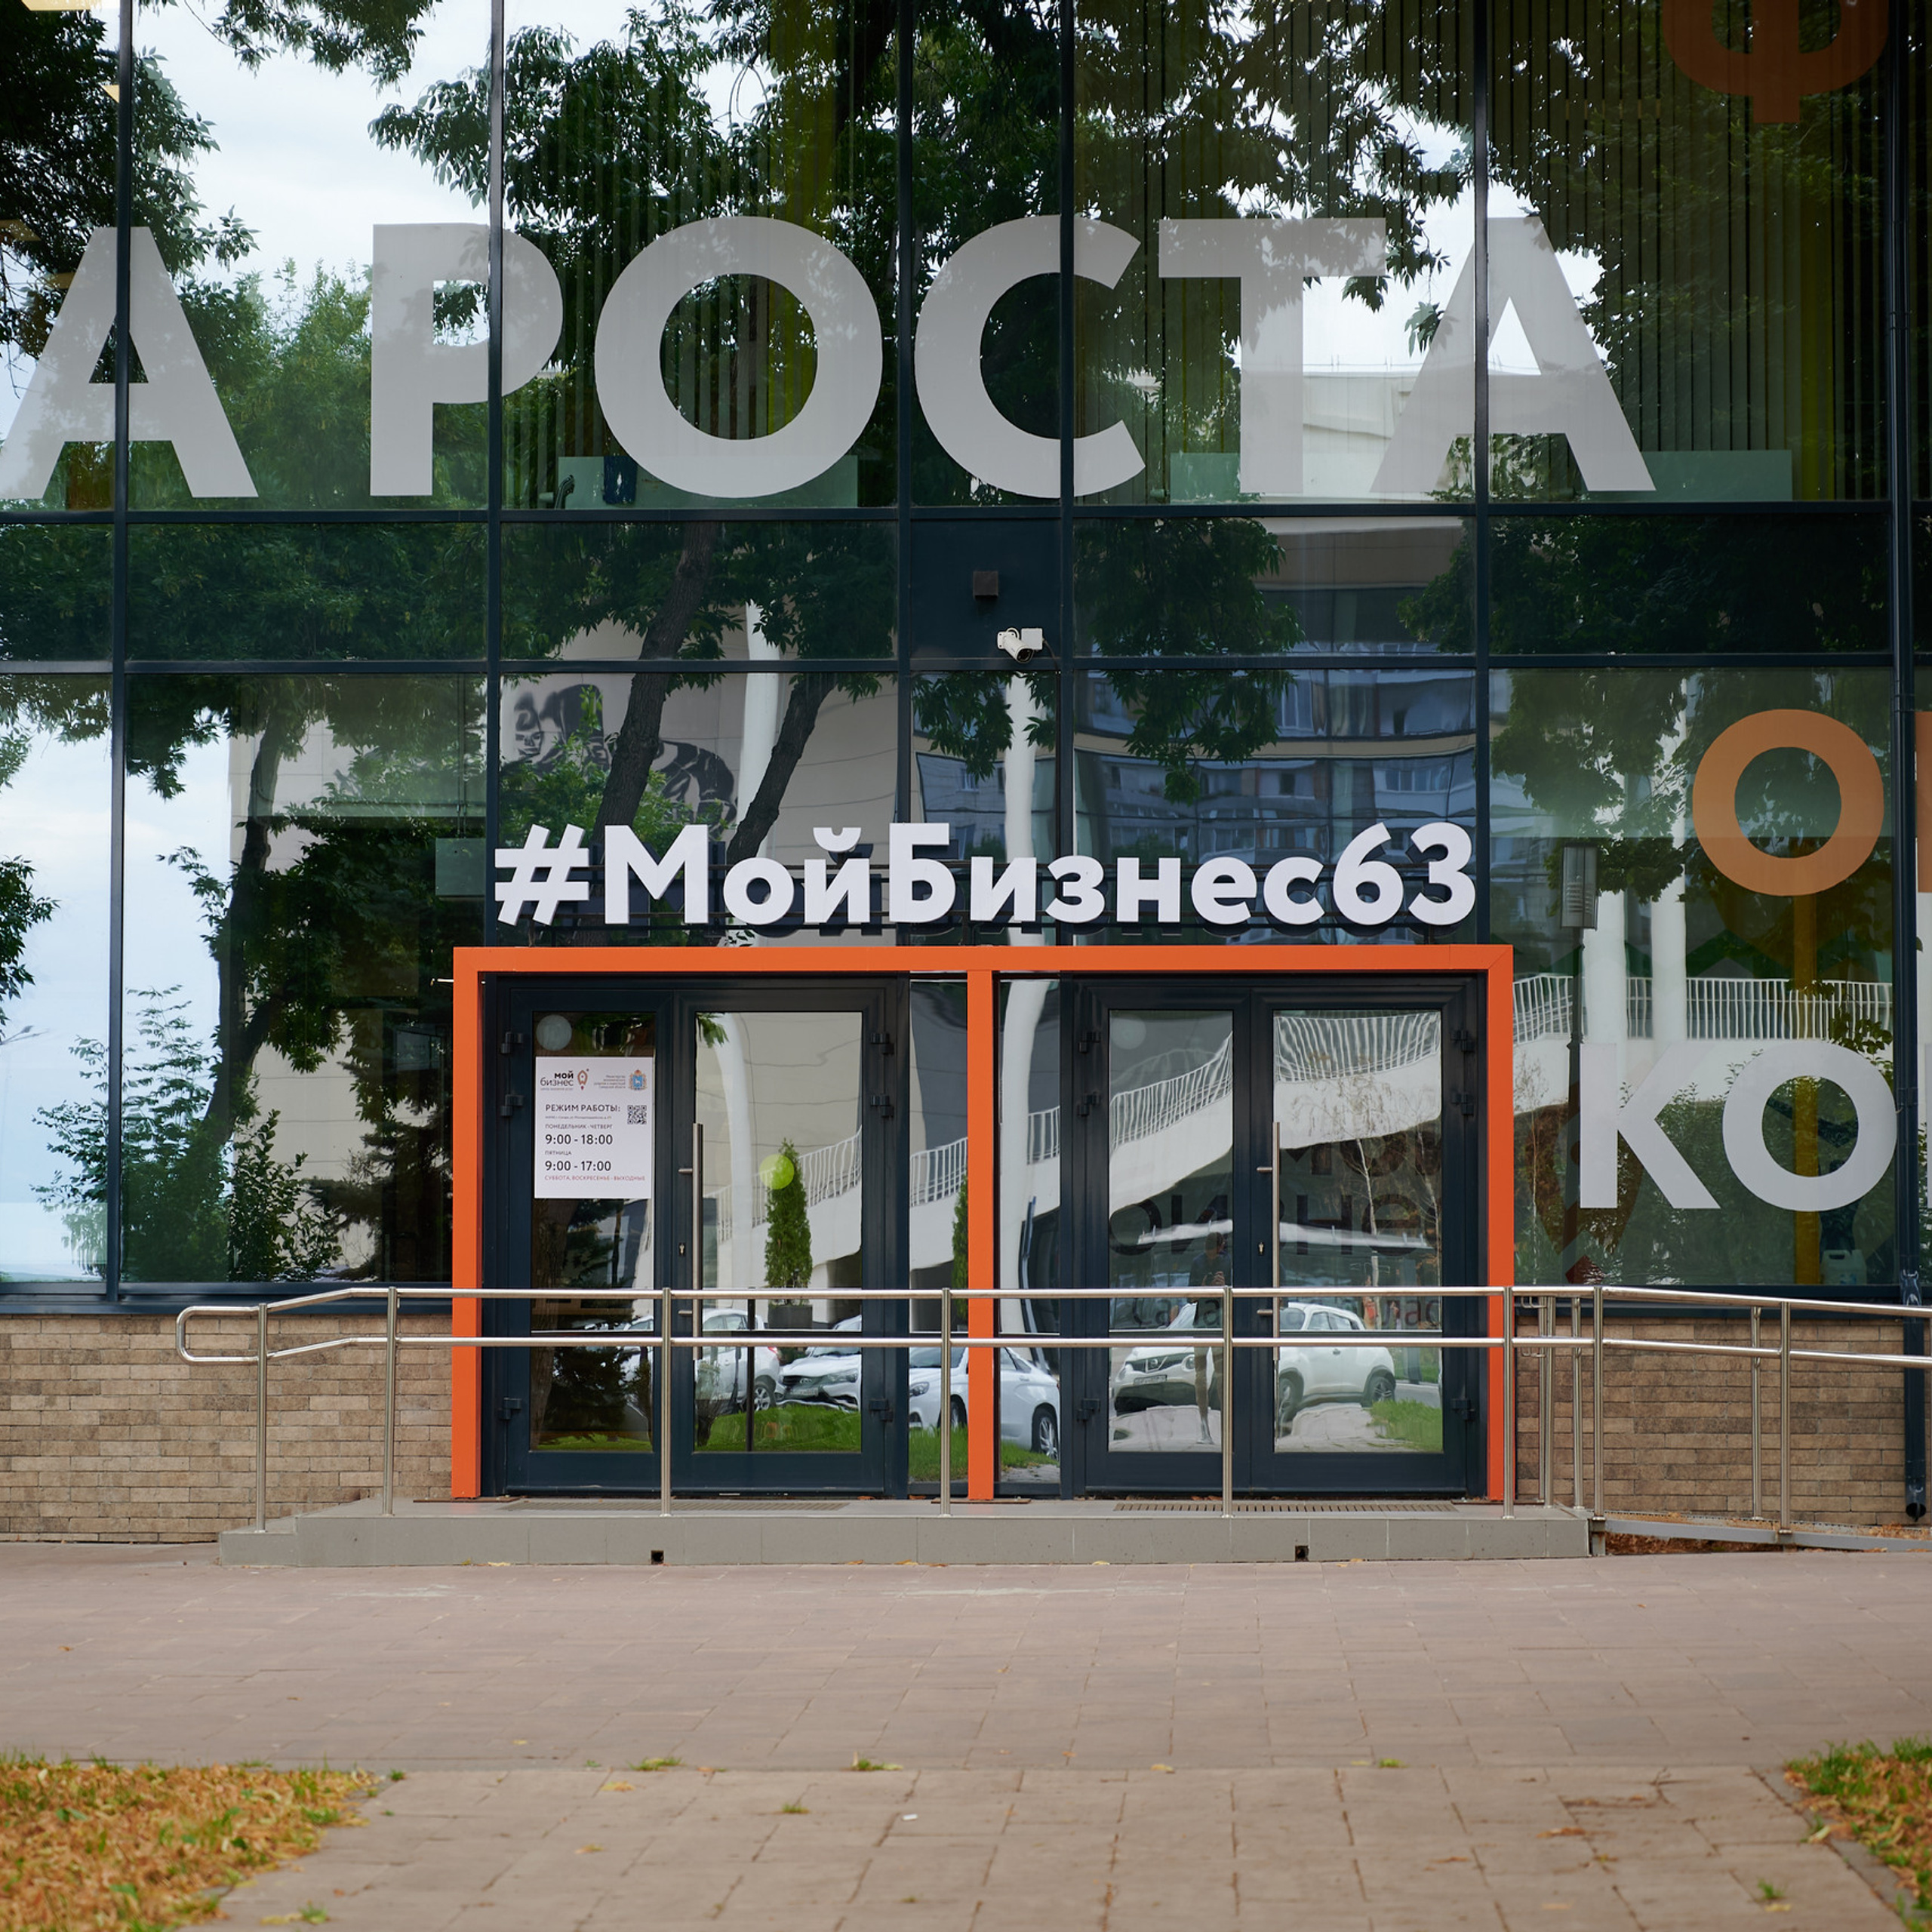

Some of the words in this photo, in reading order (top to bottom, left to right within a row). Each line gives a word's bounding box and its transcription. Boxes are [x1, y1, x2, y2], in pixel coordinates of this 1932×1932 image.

[370, 214, 1656, 499] РОСТА
[494, 822, 1476, 928] #МойБизнес63
[555, 1070, 574, 1078] мой
[540, 1077, 574, 1086] бизнес
[545, 1134, 571, 1145] 9:00
[581, 1134, 613, 1145] 18:00
[545, 1161, 571, 1171] 9:00
[581, 1161, 611, 1171] 17:00
